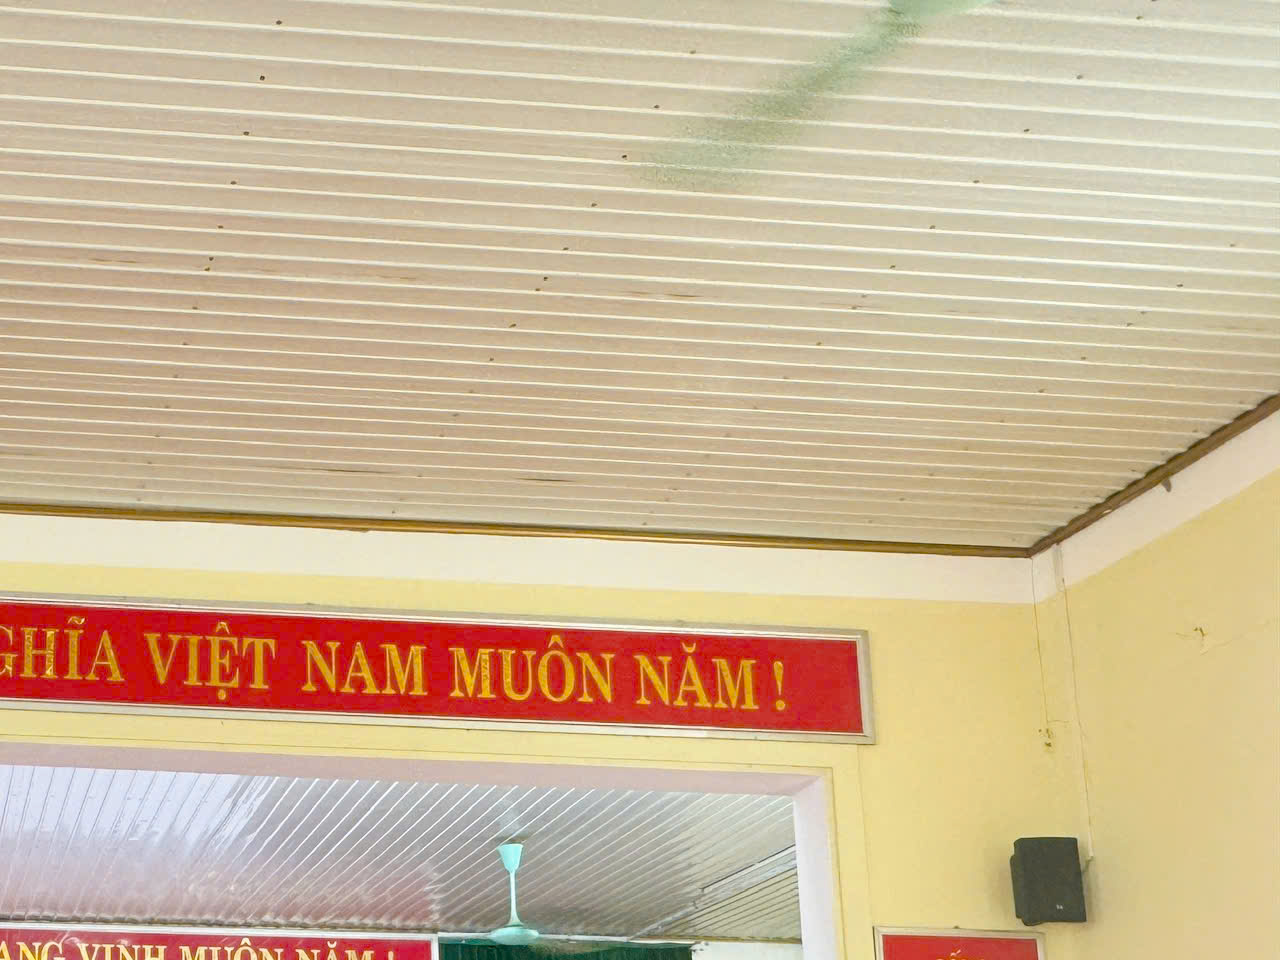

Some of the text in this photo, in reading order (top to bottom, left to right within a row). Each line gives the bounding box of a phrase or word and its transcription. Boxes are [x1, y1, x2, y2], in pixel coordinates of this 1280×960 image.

[144, 621, 276, 698] VIỆT
[301, 640, 428, 696] NAM
[448, 634, 616, 704] MUÔN
[633, 642, 760, 711] NĂM
